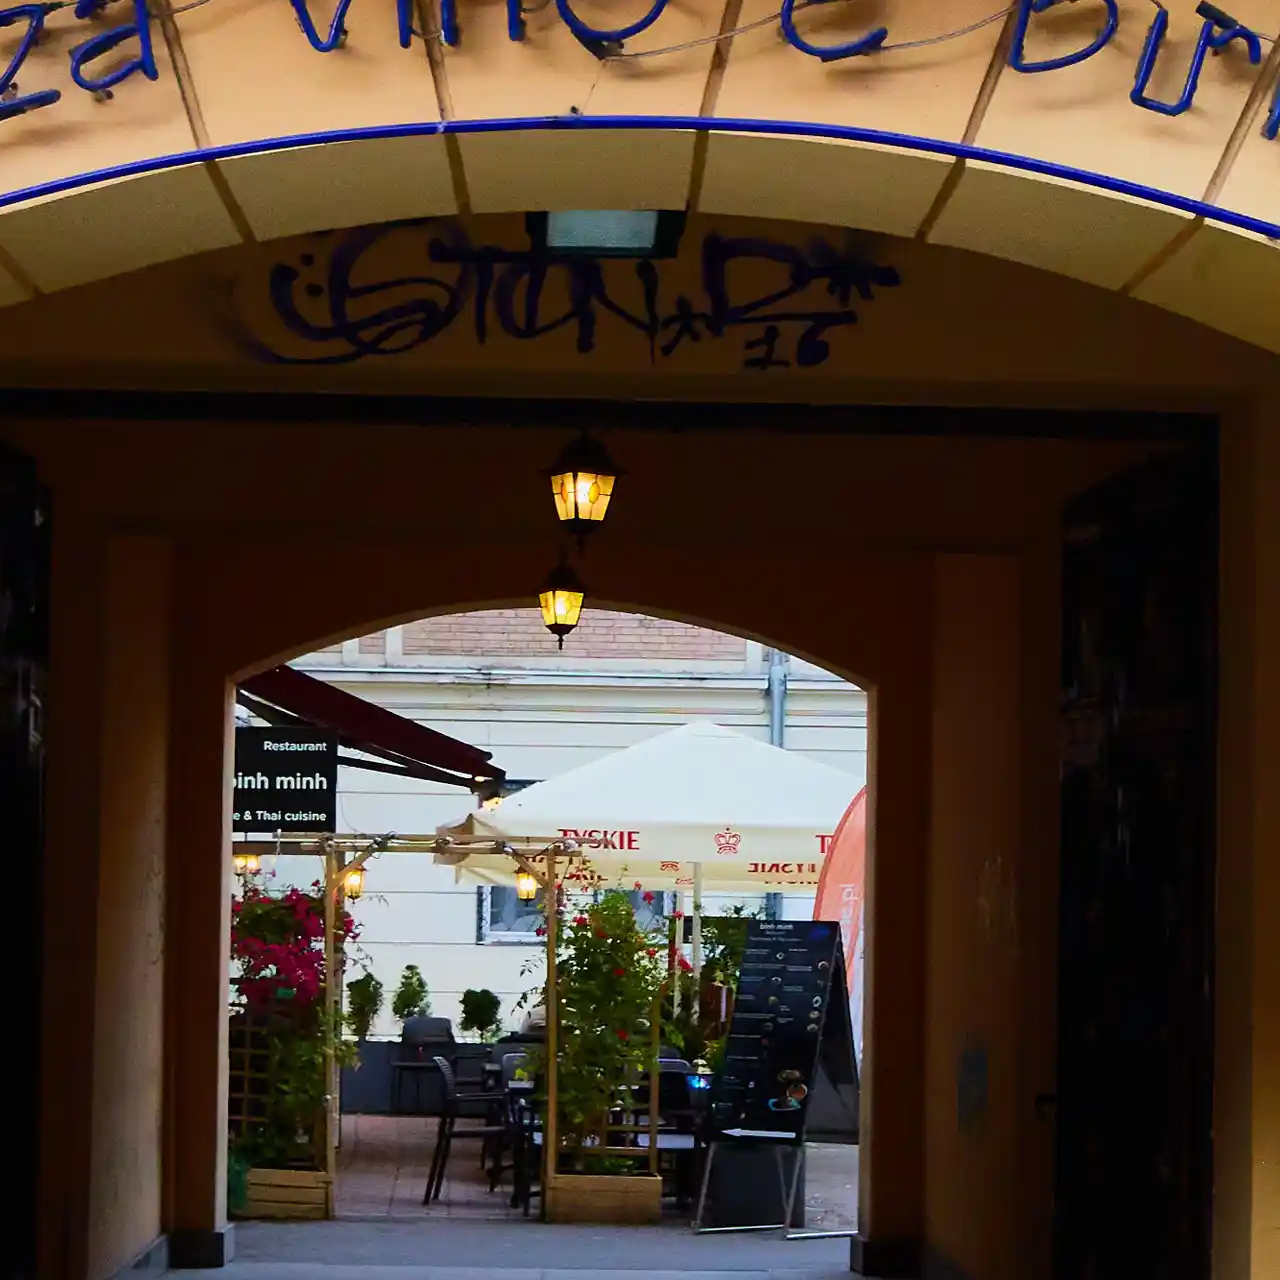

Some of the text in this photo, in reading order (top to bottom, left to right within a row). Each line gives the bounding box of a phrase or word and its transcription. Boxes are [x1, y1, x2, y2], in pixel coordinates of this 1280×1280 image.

[263, 740, 327, 751] Restaurant
[276, 772, 327, 790] minh
[243, 810, 252, 821] &
[256, 810, 281, 821] Thai
[284, 810, 327, 821] cuisine
